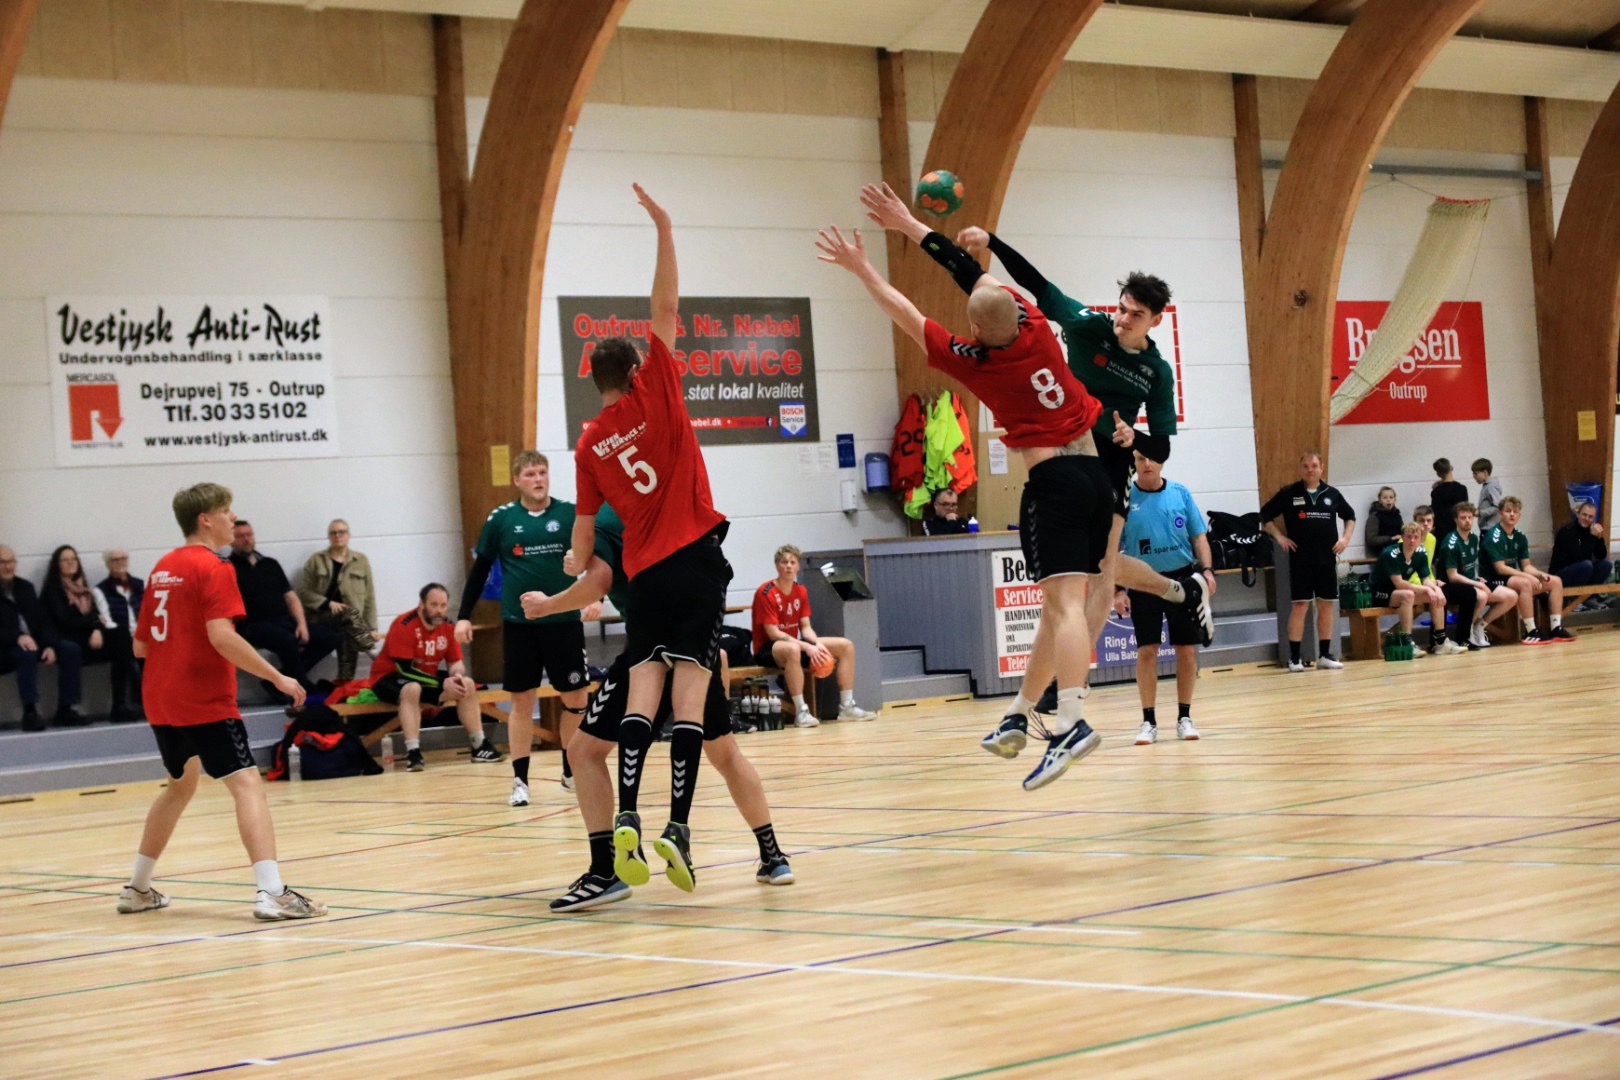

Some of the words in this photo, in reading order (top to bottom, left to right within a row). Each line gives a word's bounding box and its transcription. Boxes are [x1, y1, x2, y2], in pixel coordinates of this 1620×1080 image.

[58, 303, 173, 351] Vestjysk
[187, 303, 320, 349] Anti-Rust
[693, 314, 728, 337] Nr.
[733, 314, 800, 337] Nebel
[59, 350, 232, 365] Undervognsbehandling
[248, 350, 322, 361] særklasse
[140, 382, 222, 401] Dejrupvej
[229, 382, 249, 397] 75
[269, 381, 325, 398] Outrup
[718, 382, 754, 399] lokal
[757, 382, 804, 399] kvalitet
[1030, 367, 1065, 409] 8
[1389, 382, 1428, 403] Outrup
[781, 416, 804, 424] Service
[144, 429, 328, 446] www.vestjysk-antirust.dk
[617, 445, 658, 494] 5
[1003, 587, 1044, 606] Service
[151, 590, 170, 641] 3
[1105, 635, 1127, 650] Ring
[1007, 655, 1031, 671] Telef
[1105, 651, 1120, 662] Ulla
